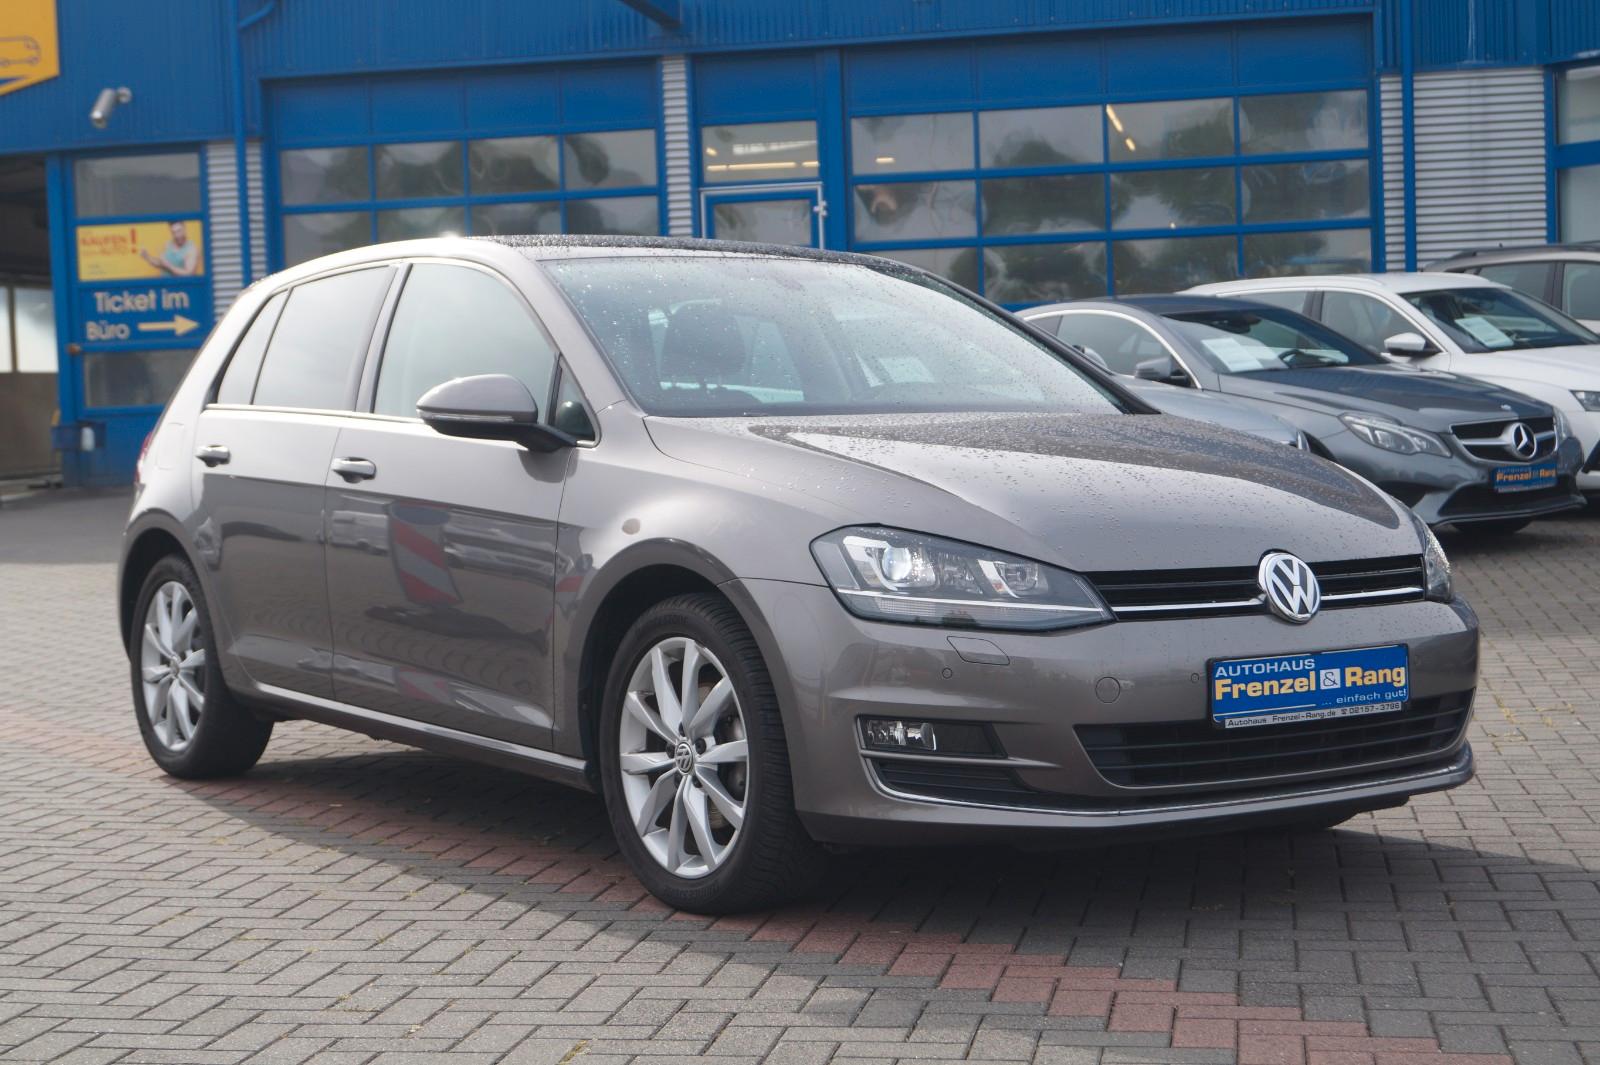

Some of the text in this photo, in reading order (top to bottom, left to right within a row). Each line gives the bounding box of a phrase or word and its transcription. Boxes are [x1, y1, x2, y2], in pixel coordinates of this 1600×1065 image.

[94, 287, 190, 313] Ticket im
[86, 320, 130, 340] Büro
[1215, 658, 1316, 678] AUTOHAUS
[1214, 666, 1406, 701] Frenzel & Rang
[1336, 692, 1381, 704] einfach
[1384, 688, 1407, 700] gut!
[1227, 717, 1267, 727] Autohaus
